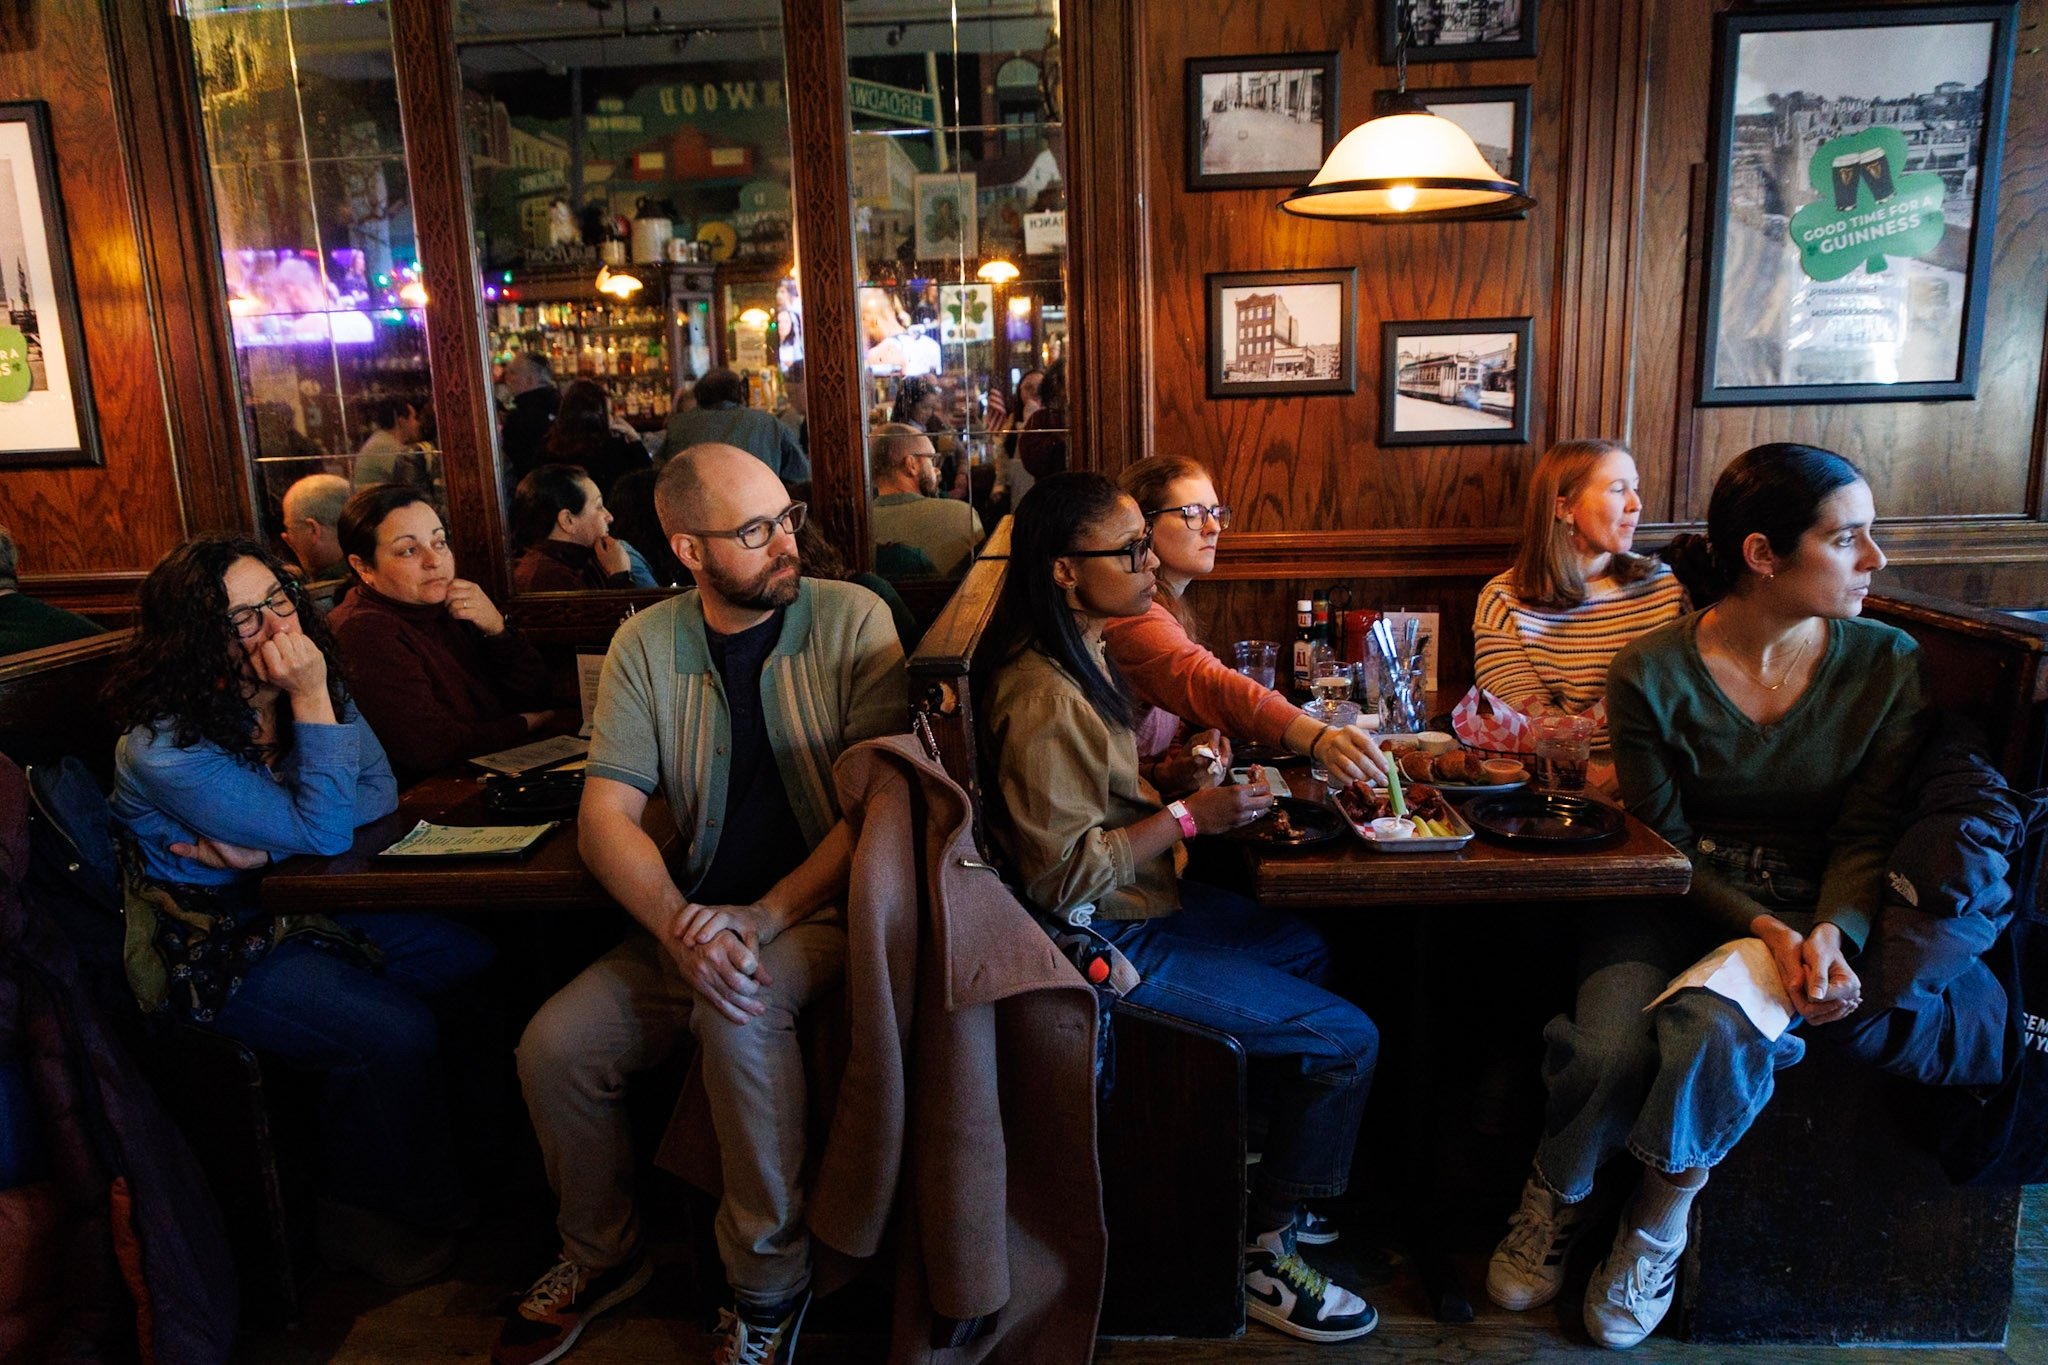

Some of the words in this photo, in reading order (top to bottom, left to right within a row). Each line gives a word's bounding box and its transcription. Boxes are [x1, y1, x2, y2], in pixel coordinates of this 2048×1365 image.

[1803, 220, 1847, 242] GOOD
[1849, 208, 1886, 228] TIME
[1889, 199, 1920, 217] FOR
[1922, 196, 1933, 207] A
[1820, 213, 1921, 254] GUINNESS
[0, 362, 11, 377] S
